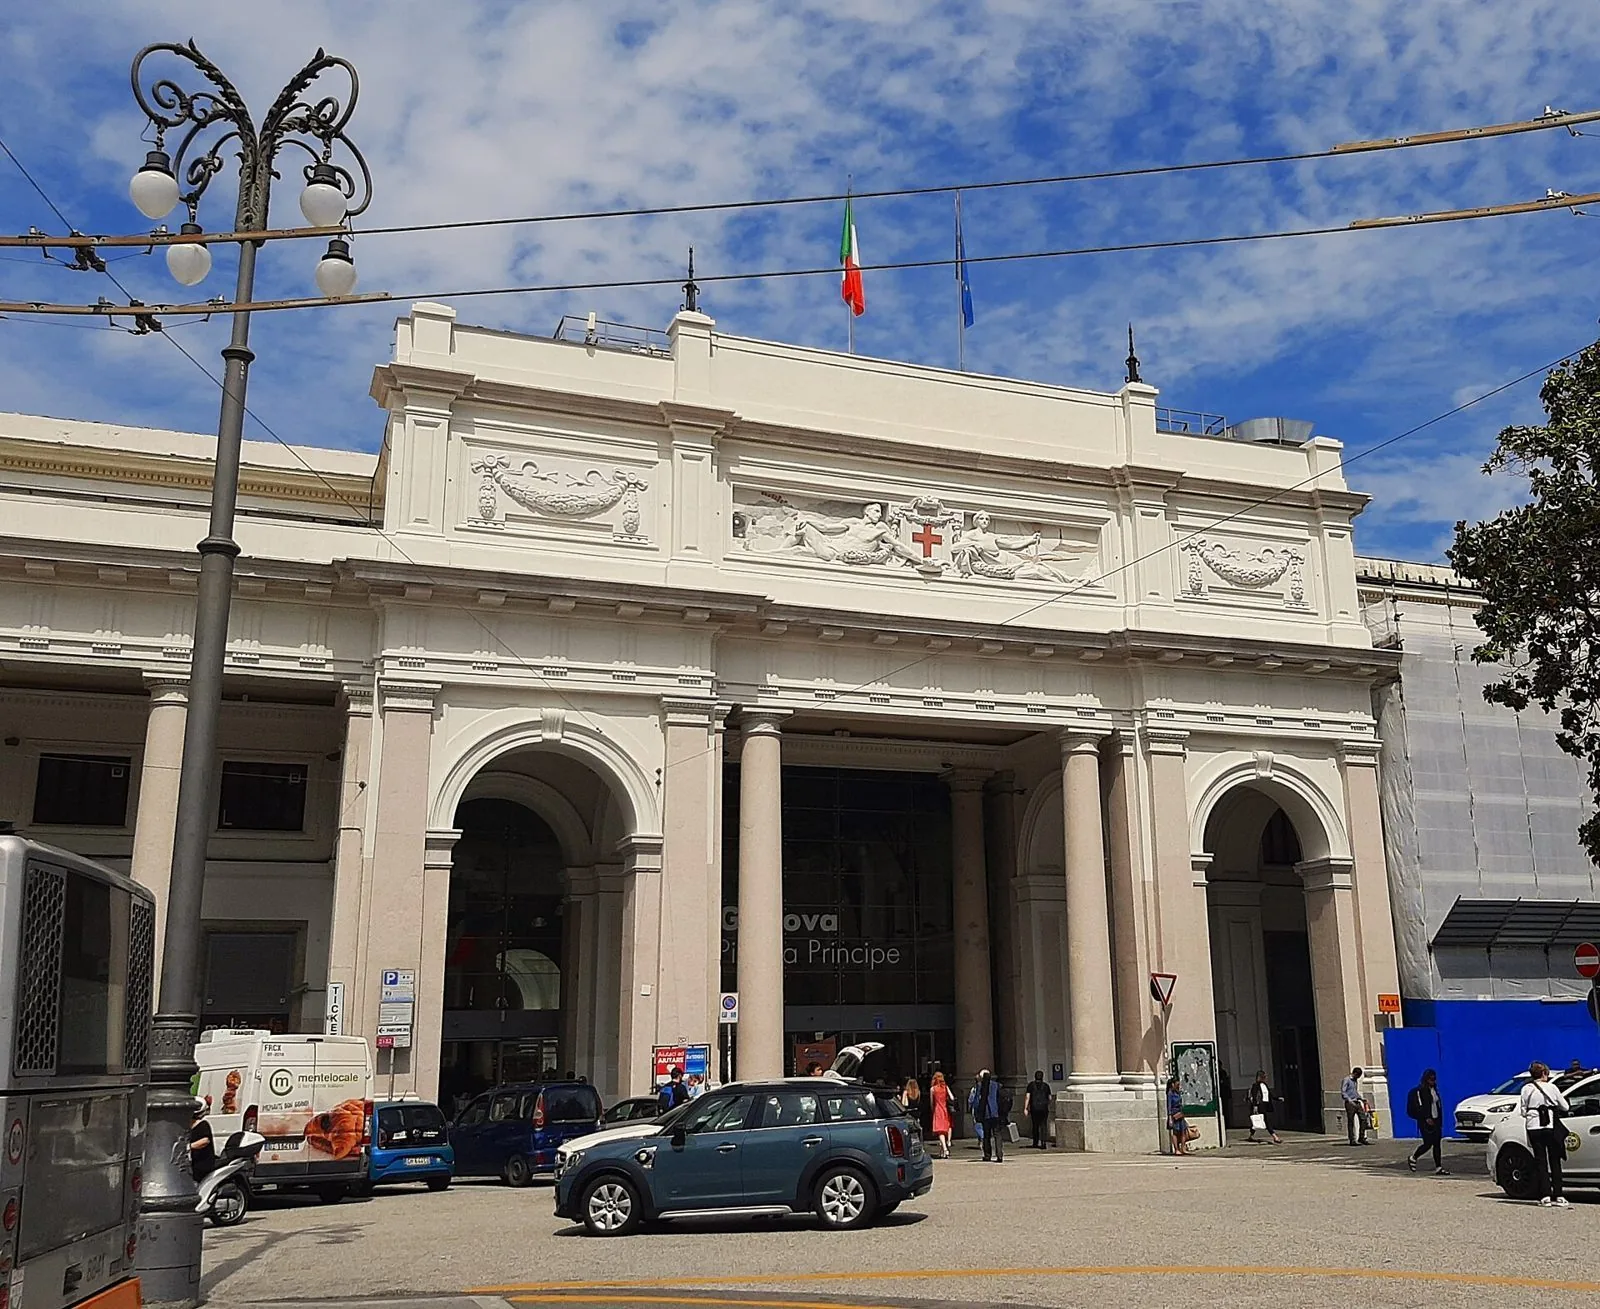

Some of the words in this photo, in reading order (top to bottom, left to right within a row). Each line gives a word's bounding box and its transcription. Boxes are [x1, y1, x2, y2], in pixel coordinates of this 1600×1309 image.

[722, 906, 838, 932] Gova
[722, 939, 798, 964] Pia
[809, 939, 901, 970] Principe
[1380, 999, 1399, 1007] TAXI
[275, 1077, 289, 1087] m
[298, 1072, 359, 1082] mentelocale
